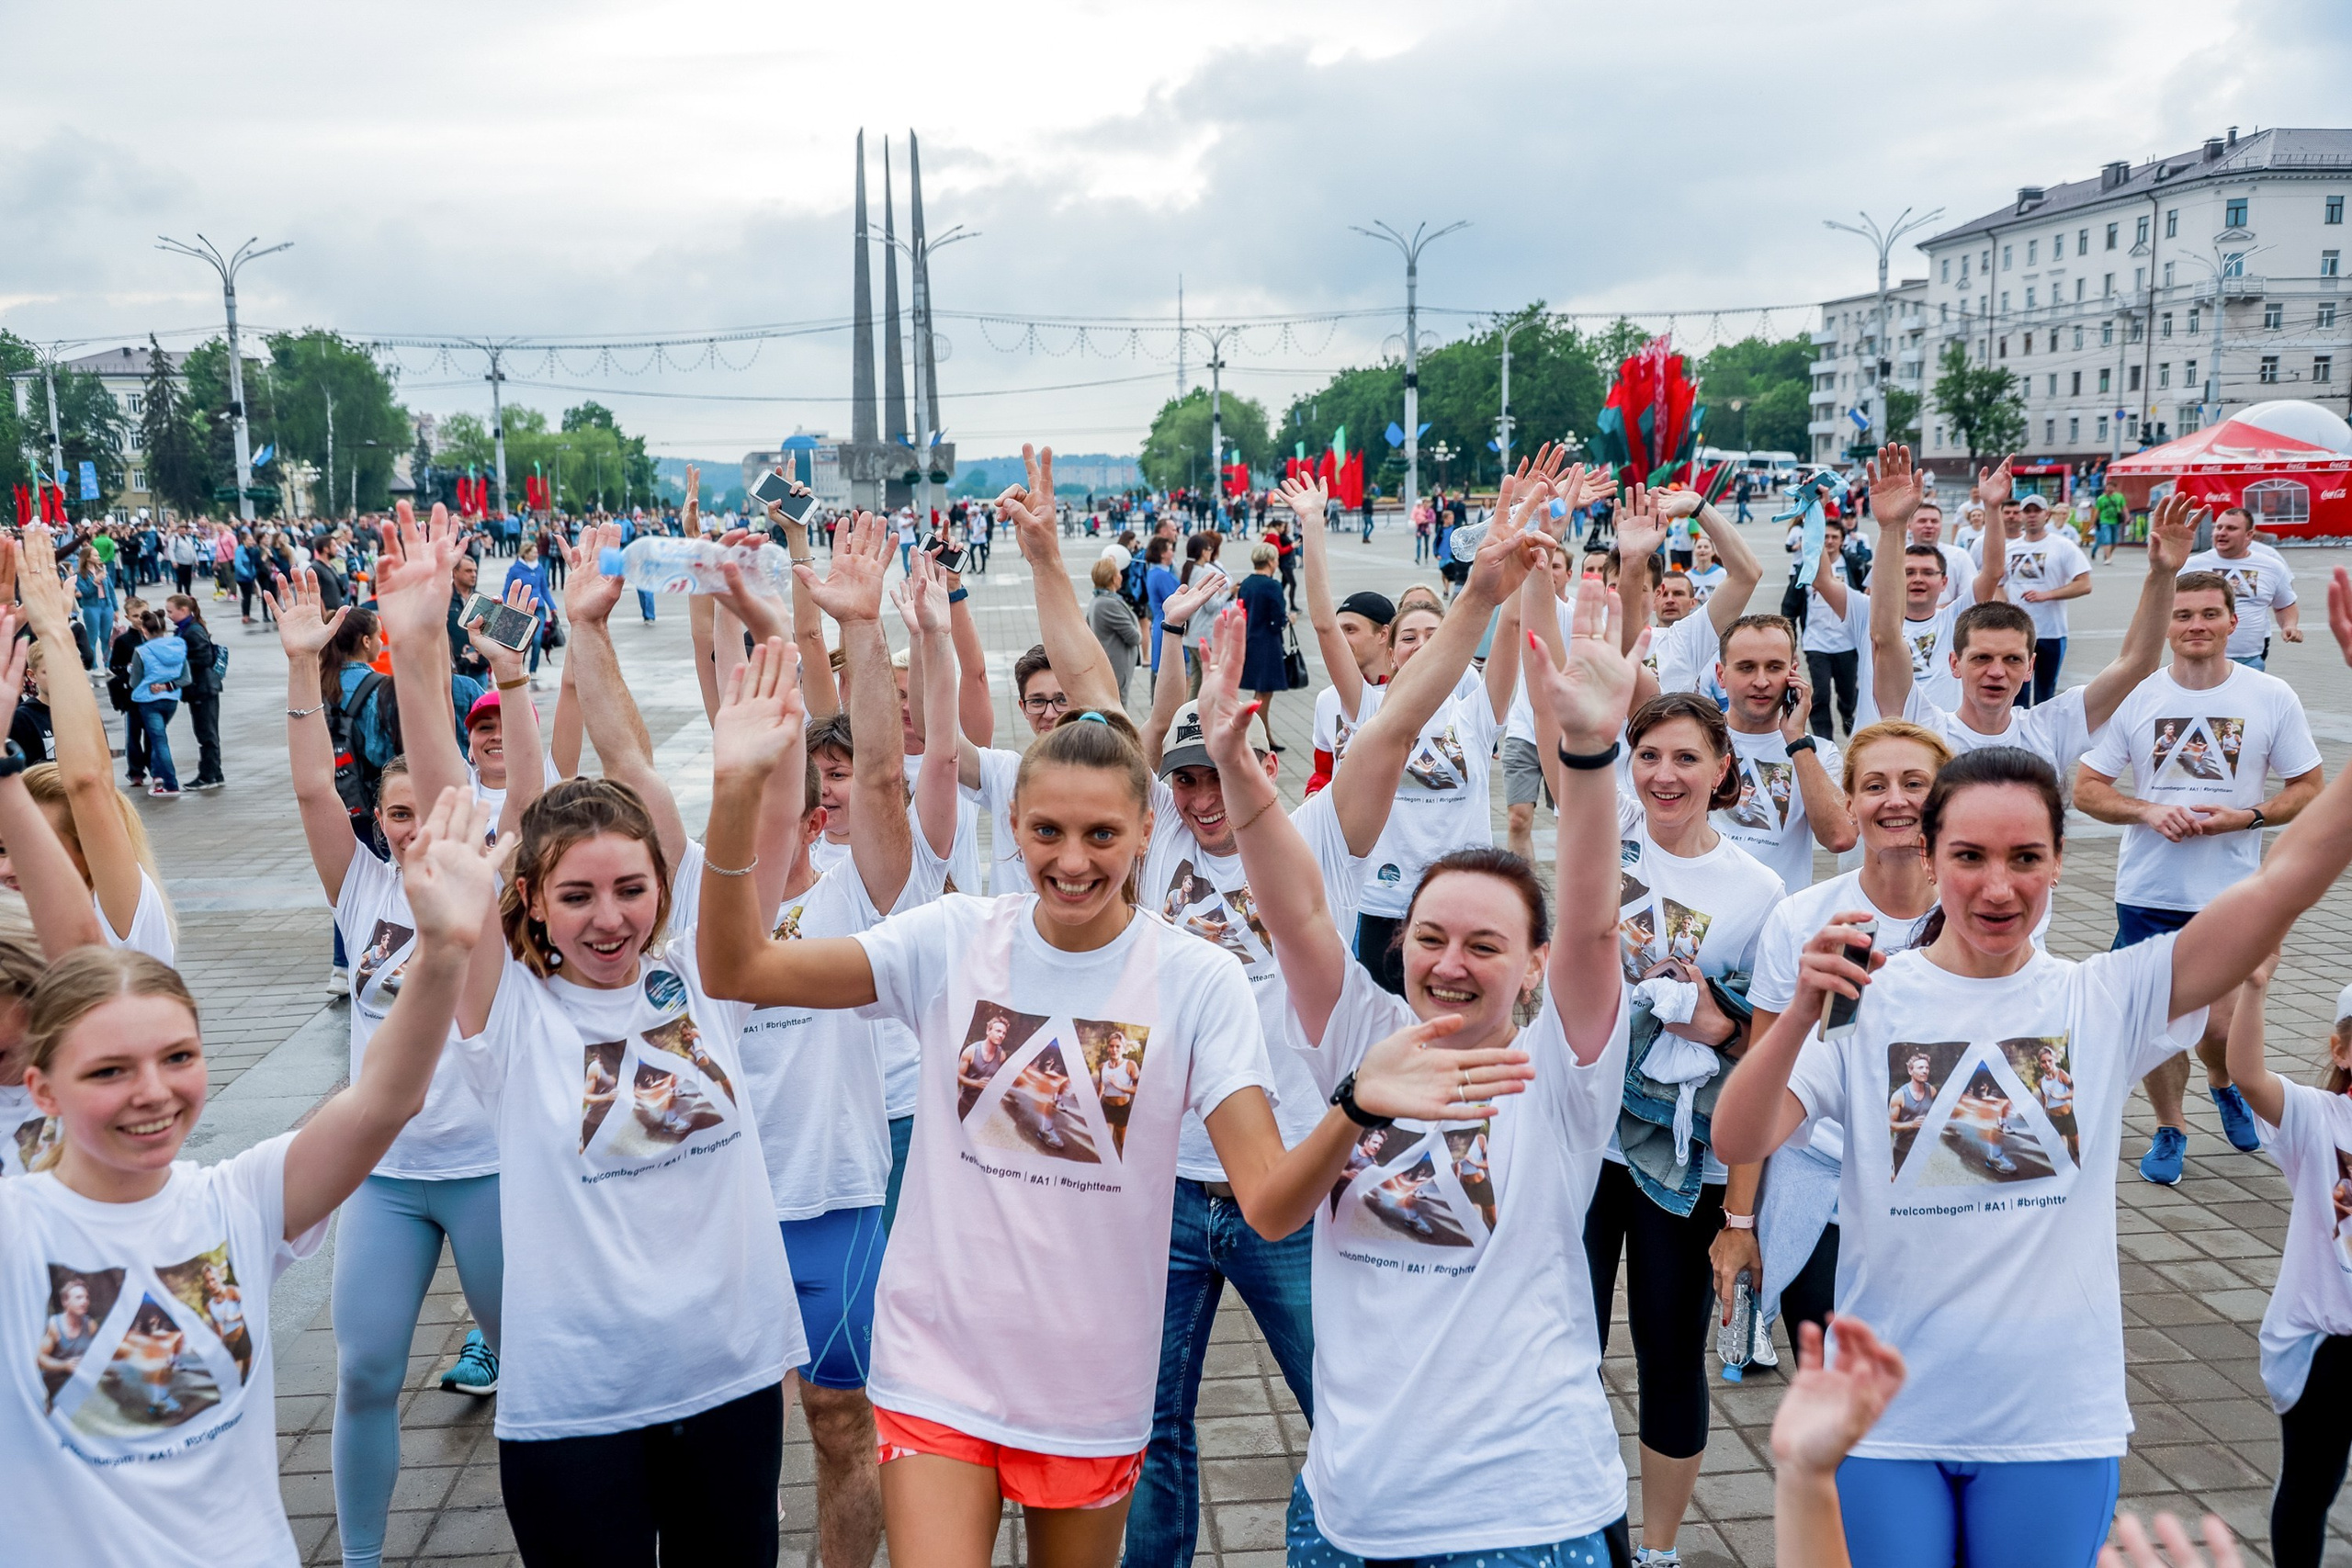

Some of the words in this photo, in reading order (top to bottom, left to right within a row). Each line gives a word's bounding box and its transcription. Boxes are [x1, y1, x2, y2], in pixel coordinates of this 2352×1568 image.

[743, 1025, 759, 1033] #A1
[766, 1016, 813, 1030] #brightteam
[1030, 1174, 1050, 1186] #A1
[1060, 1177, 1122, 1193] #brightteam
[1889, 1203, 1974, 1216] #velcombegom
[1984, 1201, 2006, 1212] #A1
[1407, 1263, 1426, 1274] #A1
